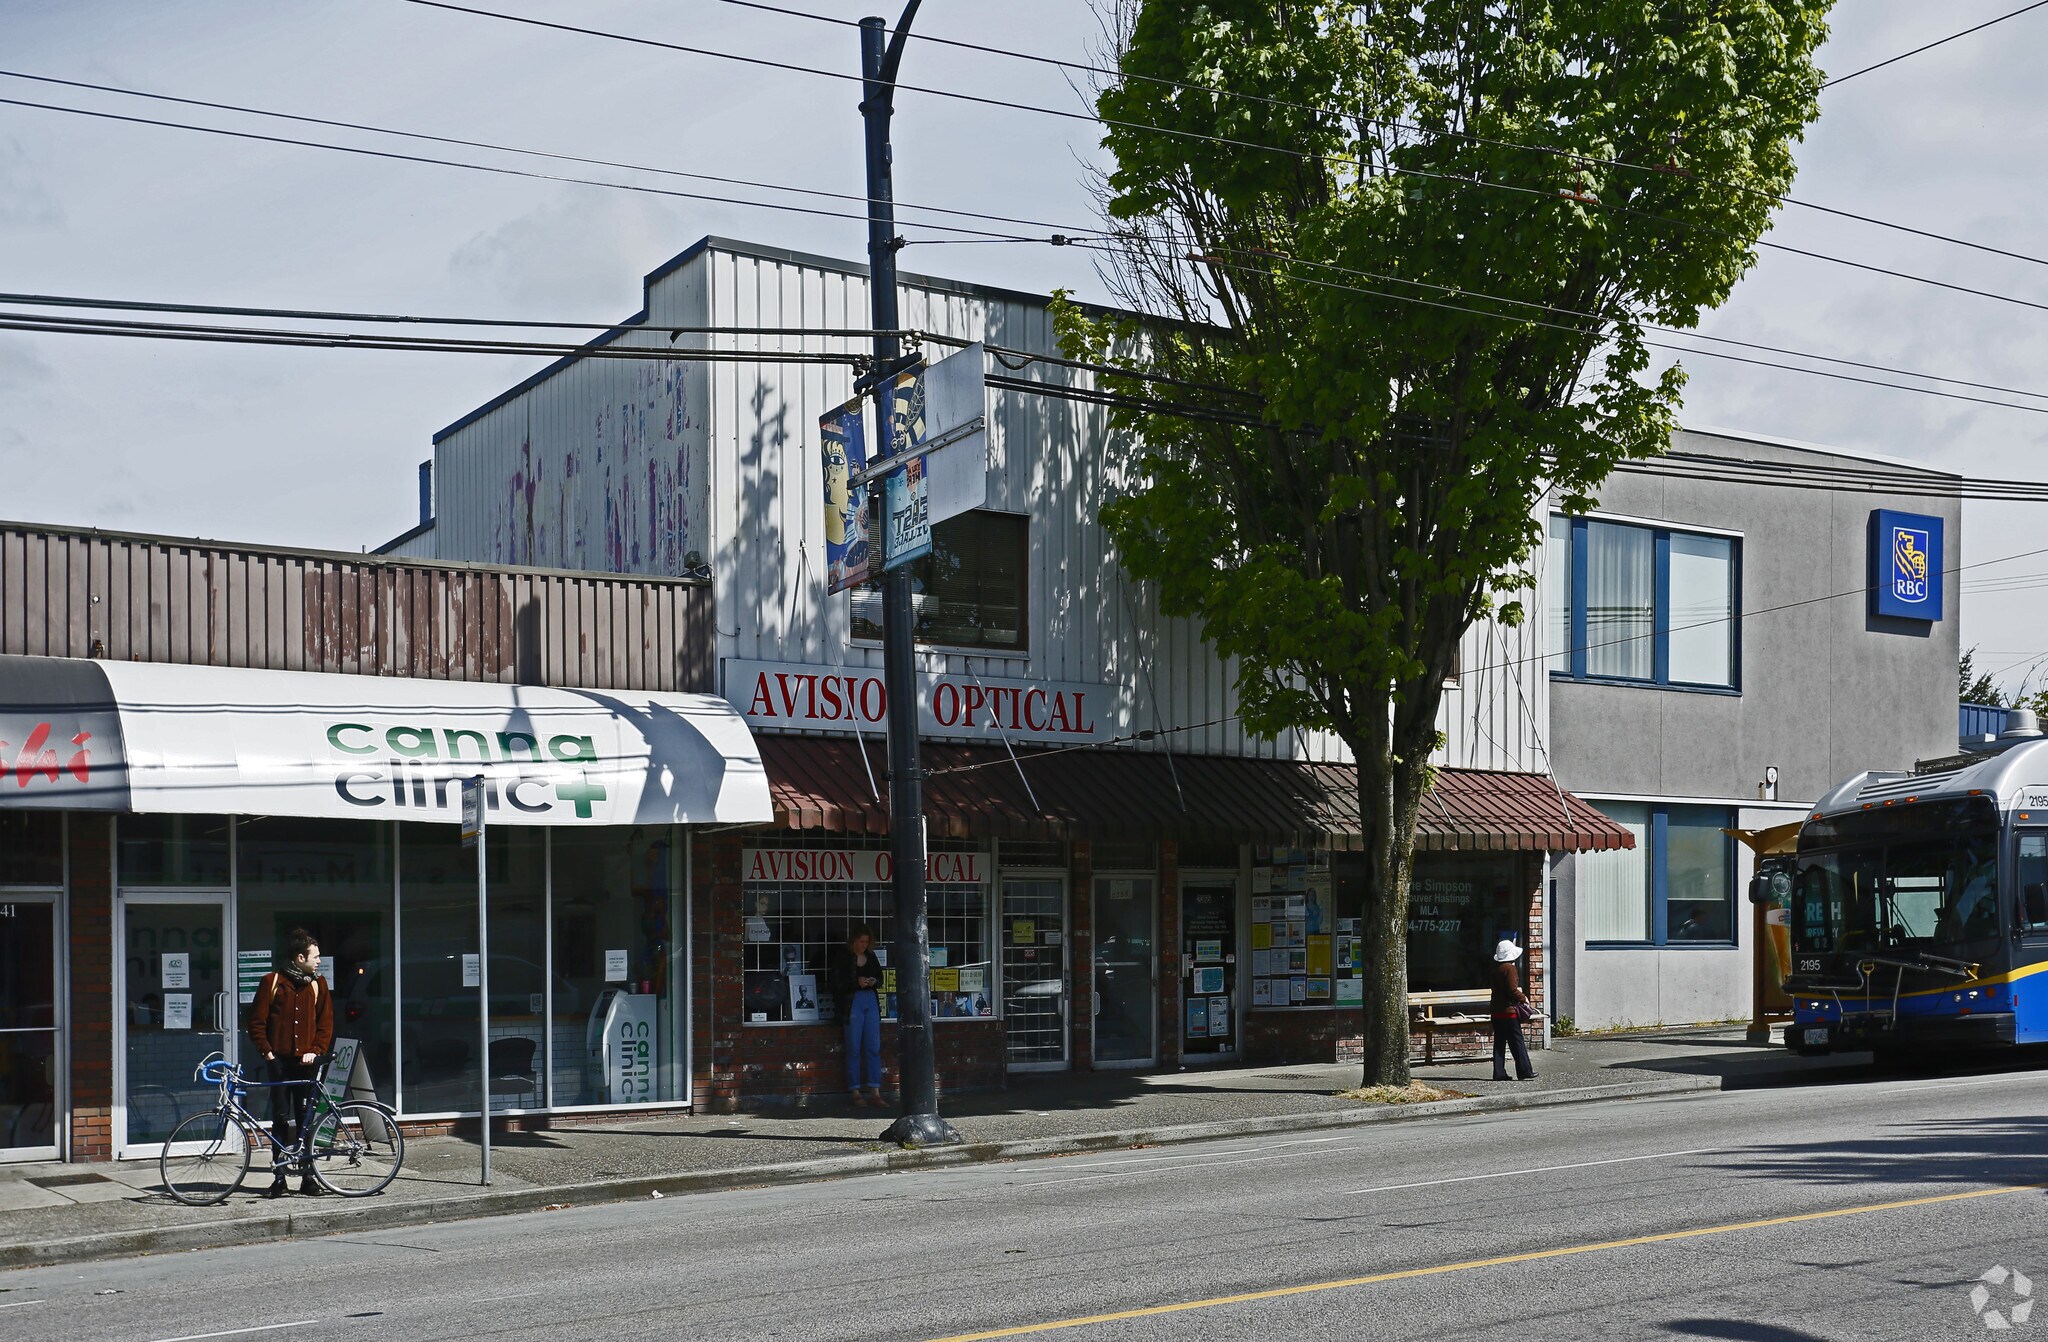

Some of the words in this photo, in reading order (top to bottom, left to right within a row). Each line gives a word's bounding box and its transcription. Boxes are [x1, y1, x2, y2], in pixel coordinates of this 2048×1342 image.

[1897, 579, 1924, 597] RBC
[747, 671, 887, 723] AVISIO
[933, 682, 1095, 734] OPTICAL
[326, 722, 598, 765] canna
[2029, 795, 2048, 807] 2195
[748, 850, 856, 881] AVISION
[875, 851, 982, 882] OICAL
[1425, 878, 1472, 894] Simpson
[1435, 892, 1471, 905] Hastings
[1420, 905, 1440, 916] MLA
[1407, 919, 1462, 932] 4-775-2277
[1801, 959, 1820, 971] 2195
[621, 1021, 637, 1095] clinic
